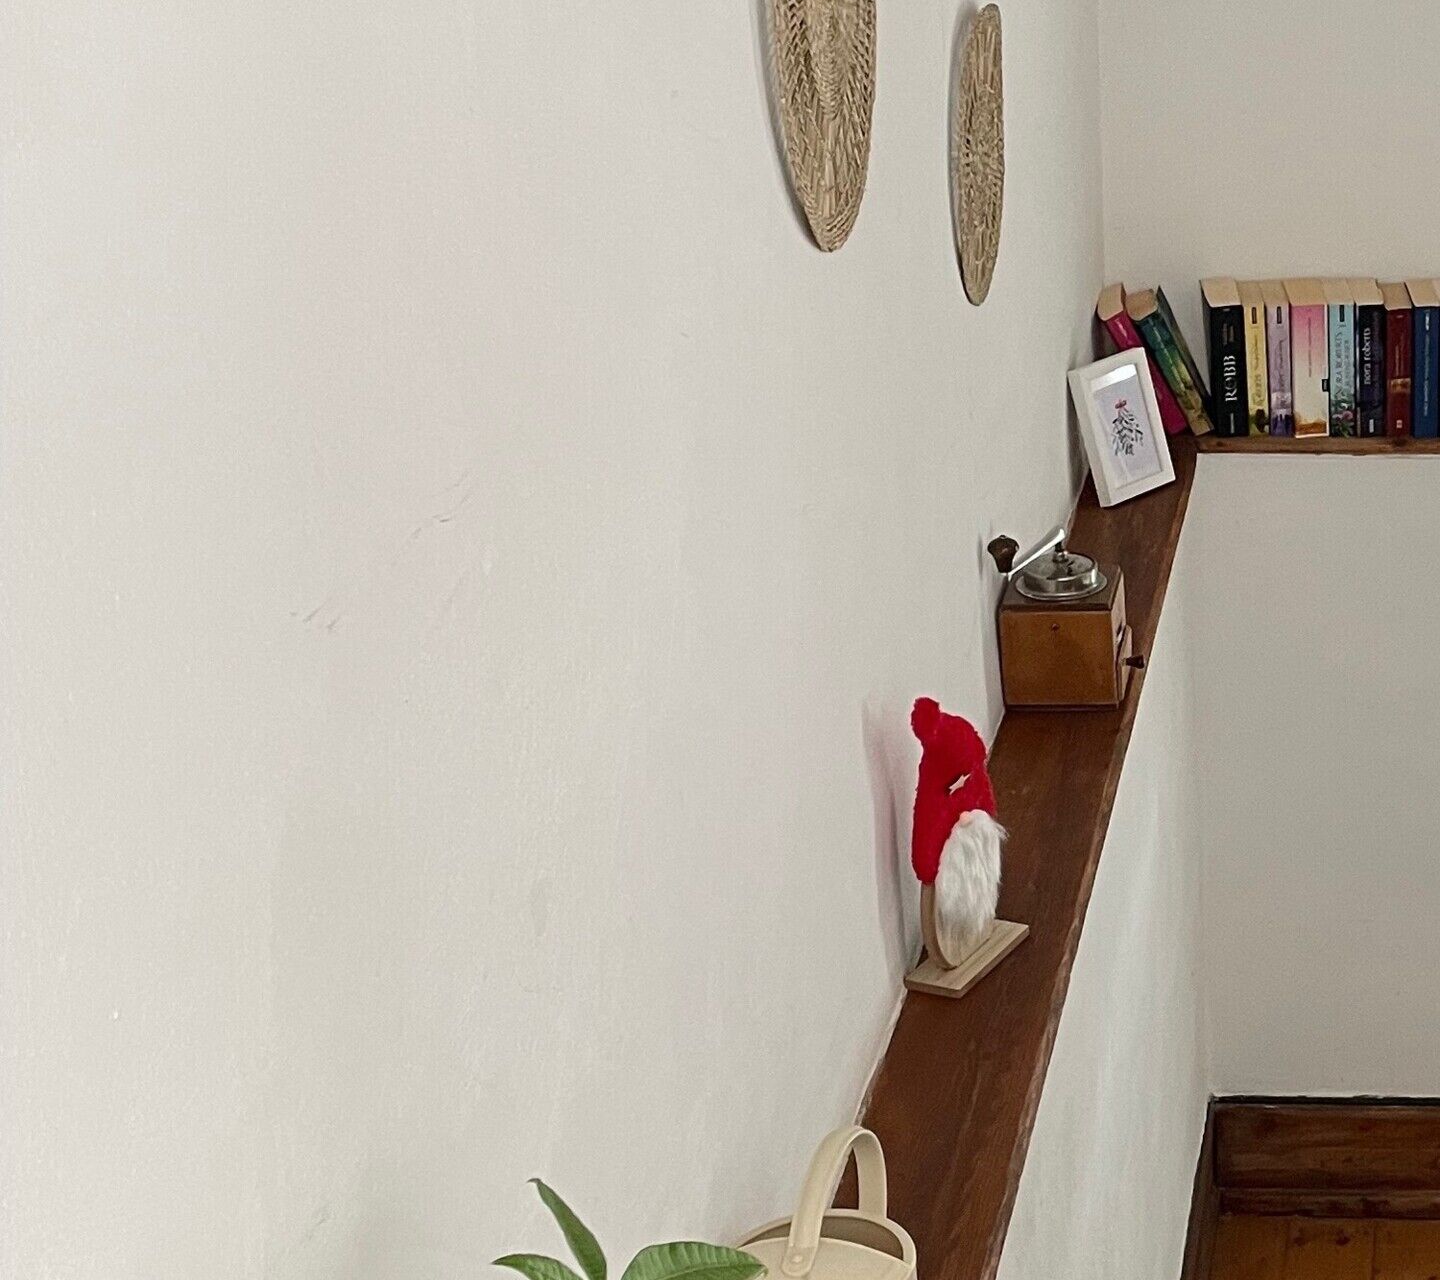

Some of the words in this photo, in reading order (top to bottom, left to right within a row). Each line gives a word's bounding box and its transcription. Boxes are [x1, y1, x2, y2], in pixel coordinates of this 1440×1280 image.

[1362, 327, 1371, 361] roberts
[1223, 354, 1238, 402] ROBB
[1363, 363, 1371, 385] nora
